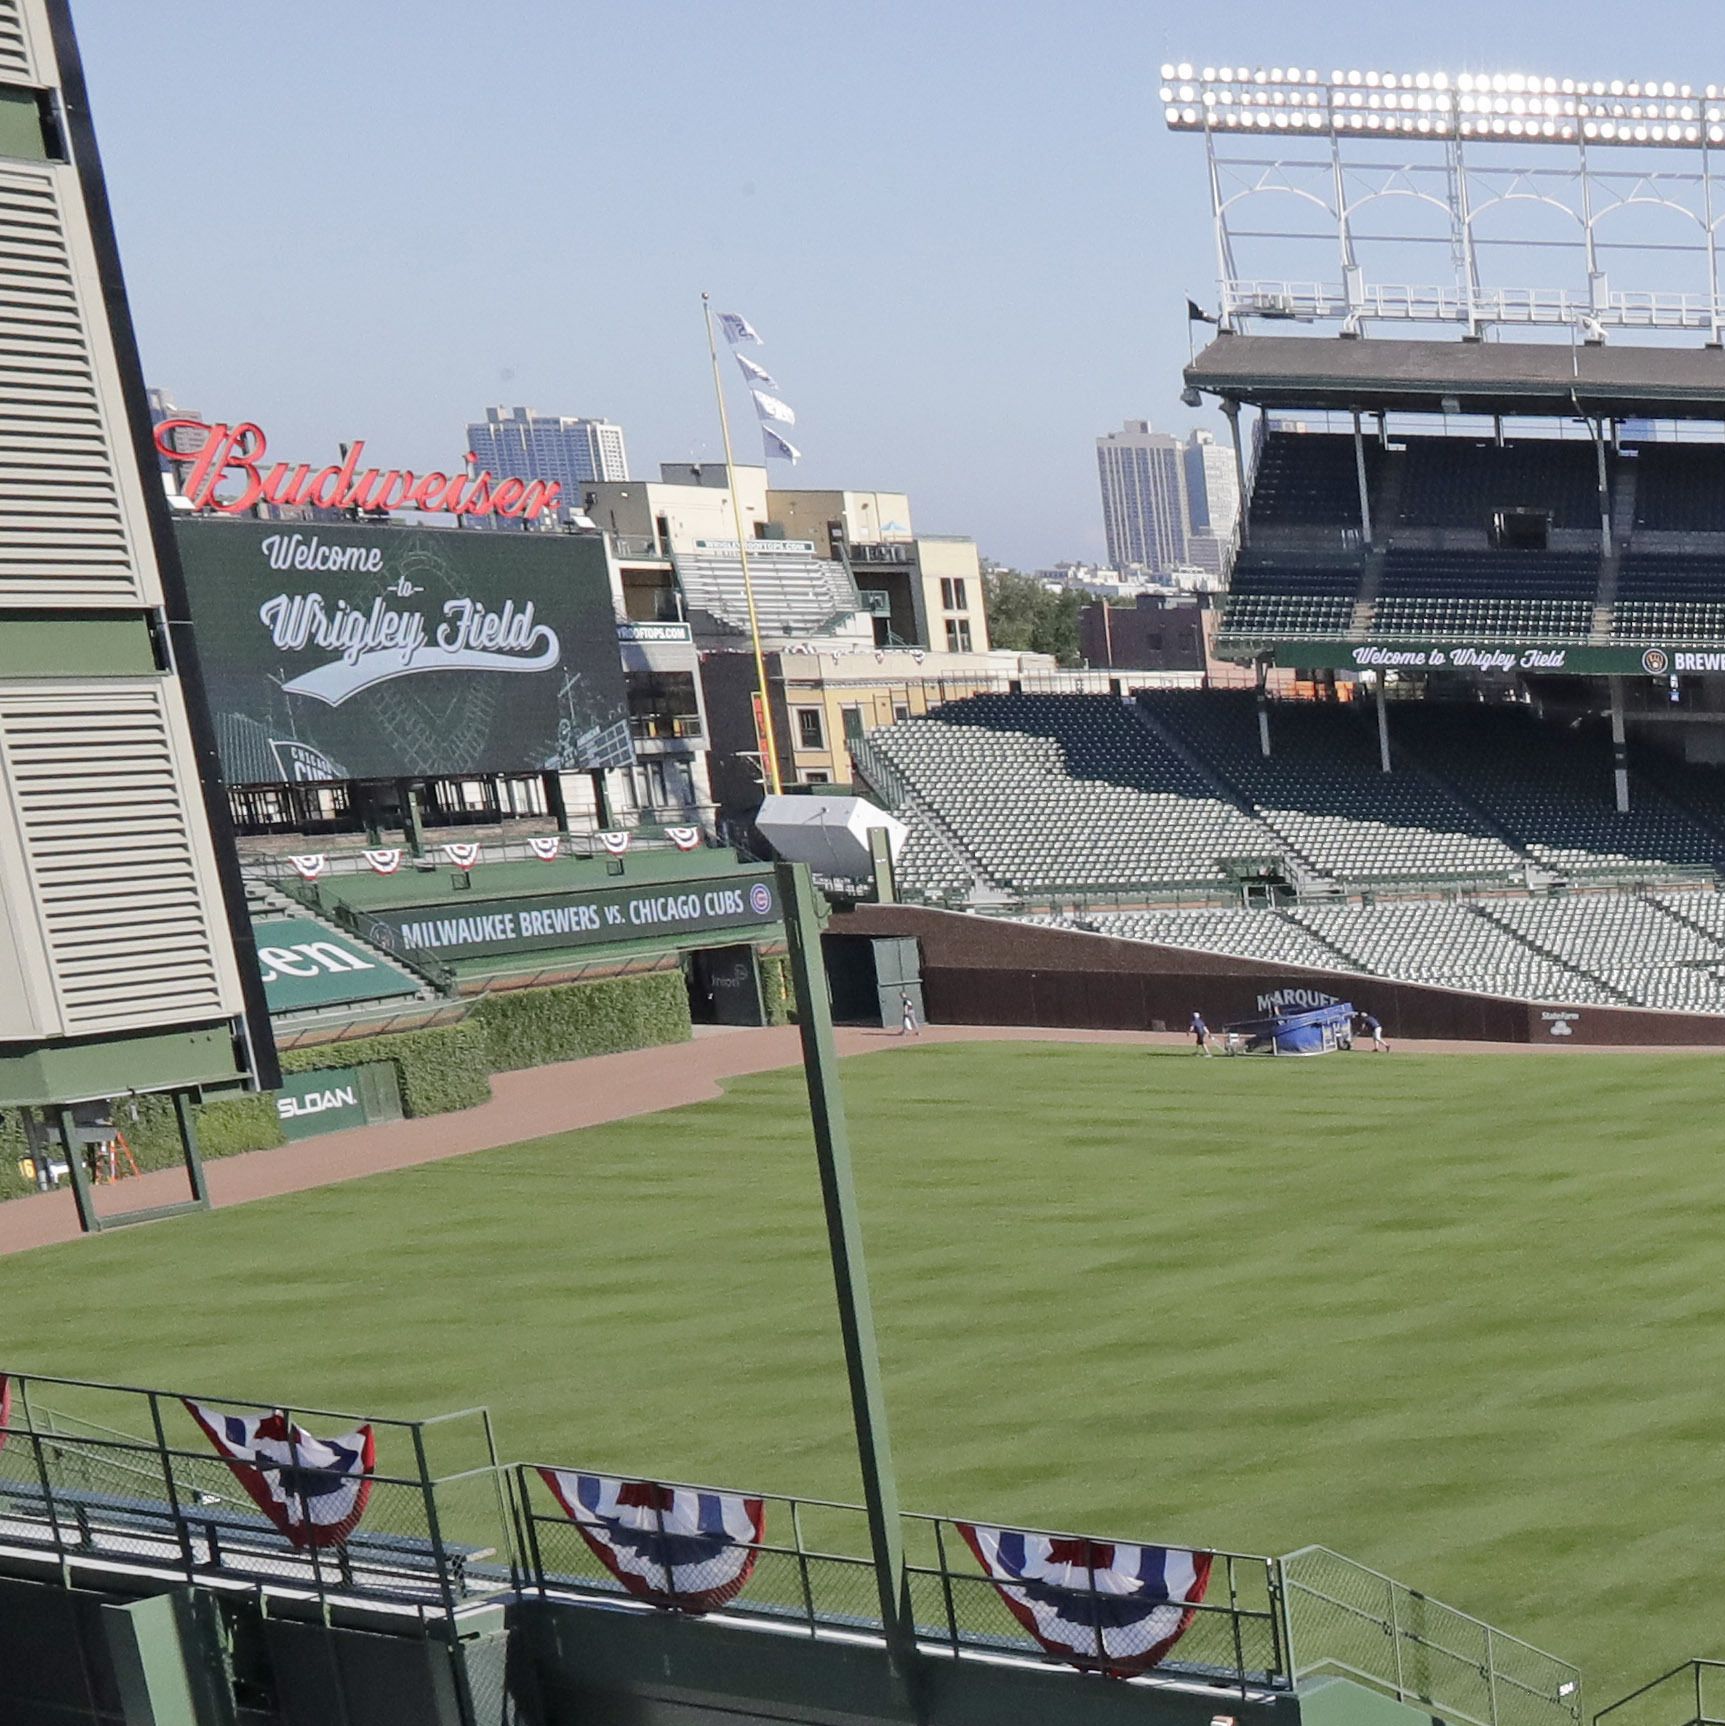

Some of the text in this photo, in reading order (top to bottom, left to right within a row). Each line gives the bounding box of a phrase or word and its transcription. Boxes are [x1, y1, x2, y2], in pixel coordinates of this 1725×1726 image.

[154, 419, 561, 521] Budweiser
[262, 534, 384, 573] Welcome
[260, 592, 537, 666] Wrigley Field
[1352, 646, 1565, 672] Welcome to Wrigley Field
[402, 912, 518, 951] MILWAUKEE
[520, 904, 600, 938] BREWERS
[630, 894, 701, 924] CHICAGO
[704, 888, 745, 917] CUBS
